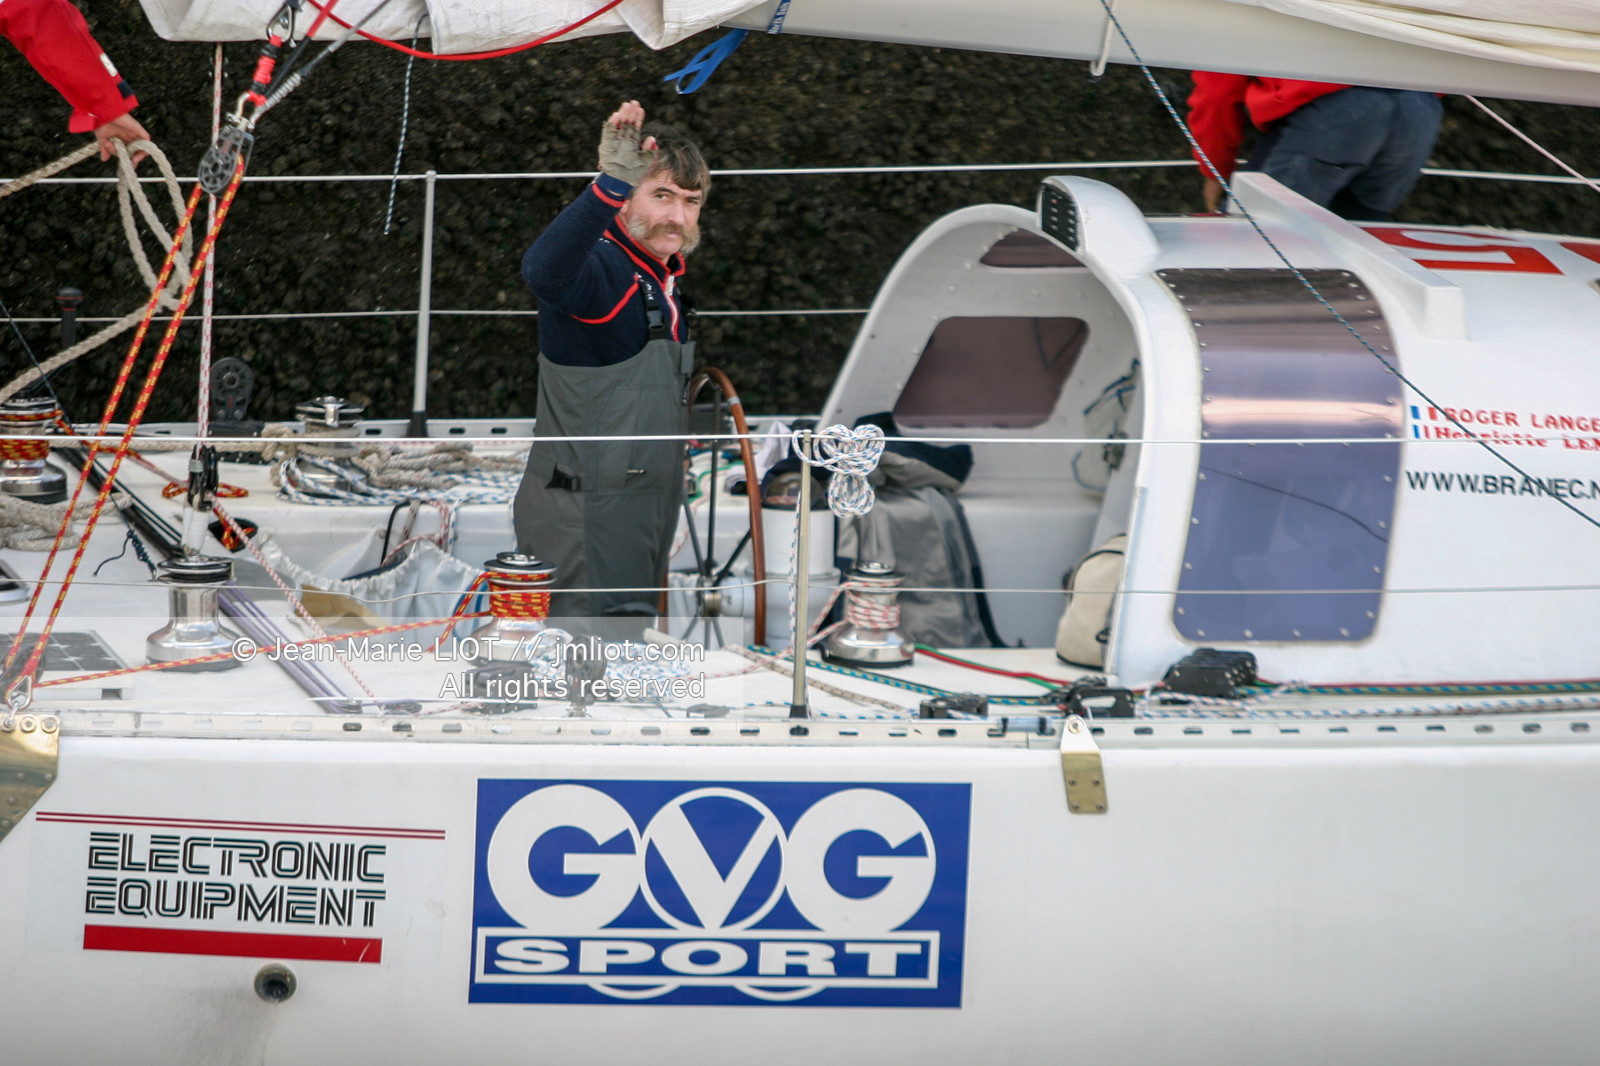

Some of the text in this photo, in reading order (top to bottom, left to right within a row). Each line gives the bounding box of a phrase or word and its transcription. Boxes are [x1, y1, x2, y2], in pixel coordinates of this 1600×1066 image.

[1443, 407, 1520, 427] ROGER
[88, 831, 387, 884] ELECTRONIC
[487, 784, 937, 933] GVG
[85, 875, 387, 928] EQUIPMENT
[494, 938, 923, 977] SPORT
